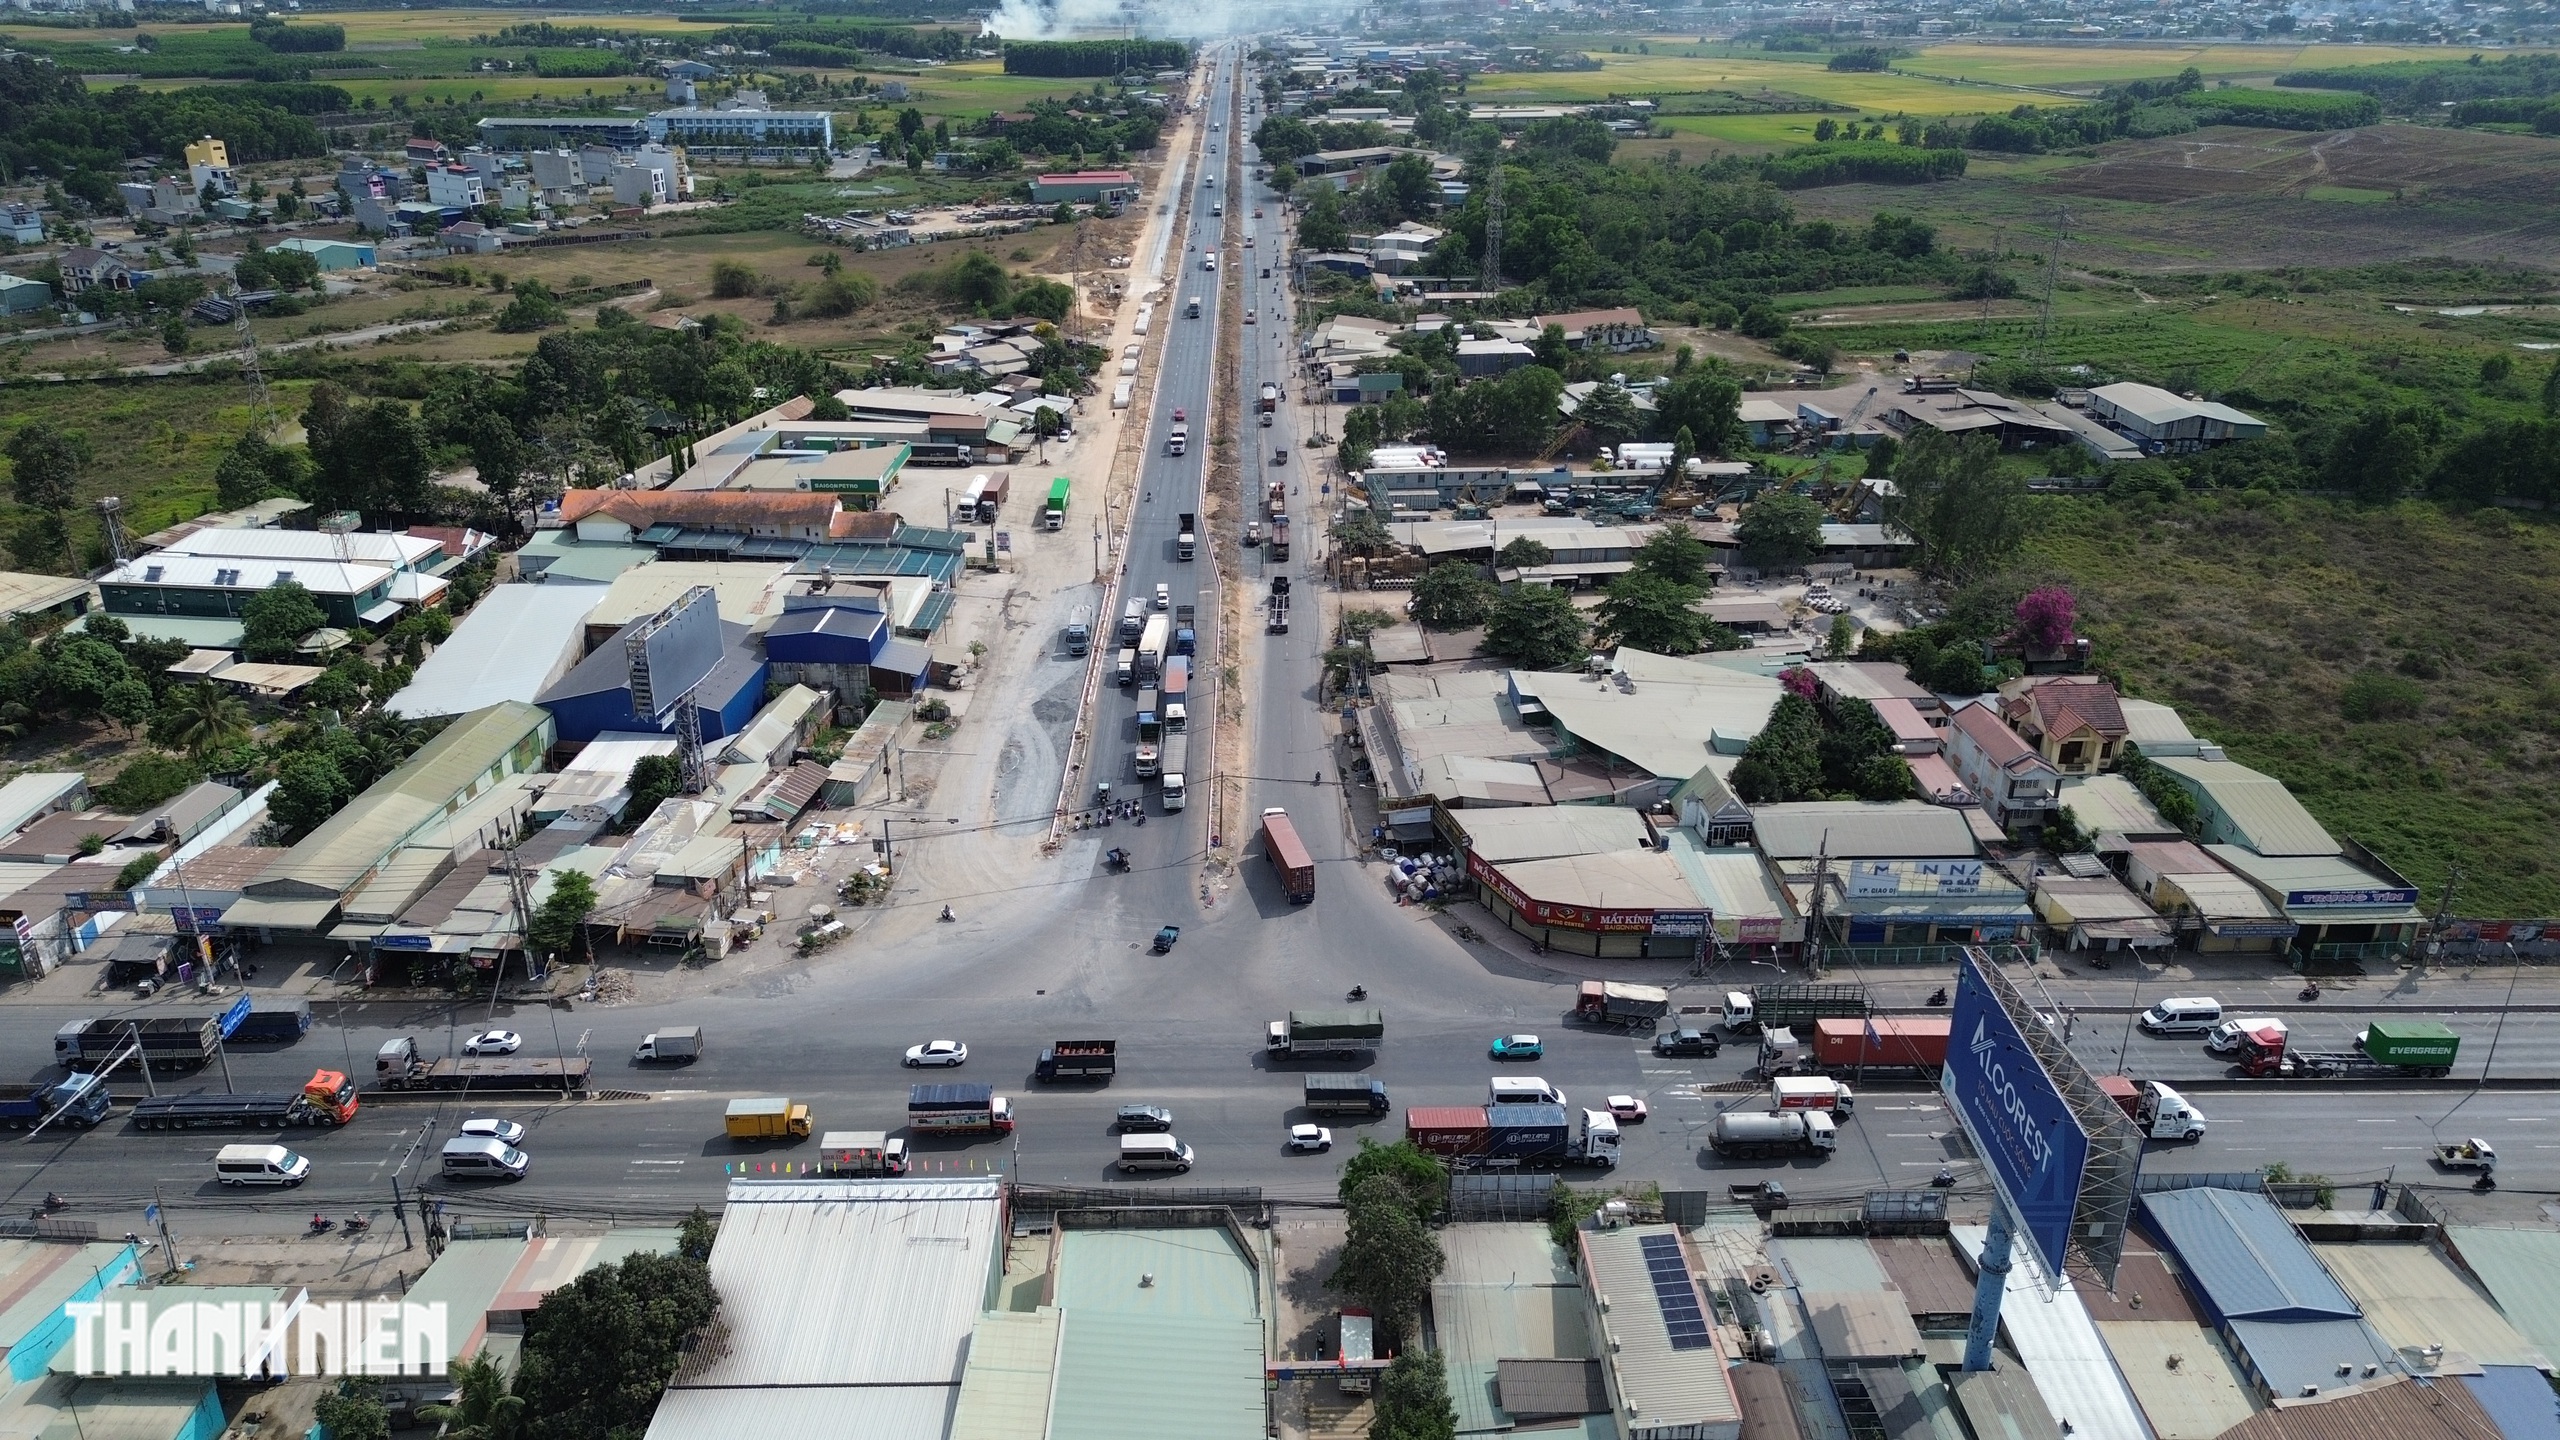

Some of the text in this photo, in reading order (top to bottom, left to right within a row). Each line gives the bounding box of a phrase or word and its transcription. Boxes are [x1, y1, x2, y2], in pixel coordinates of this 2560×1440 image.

[1473, 860, 1527, 911] MẮT KÍNH
[2302, 892, 2405, 903] TRUNG TÍN
[1546, 918, 1563, 926] OPTIC
[1600, 912, 1653, 924] MẮT KÍNH
[2389, 1046, 2452, 1055] EVERGREEN
[1970, 1014, 2053, 1173] ALCOREST
